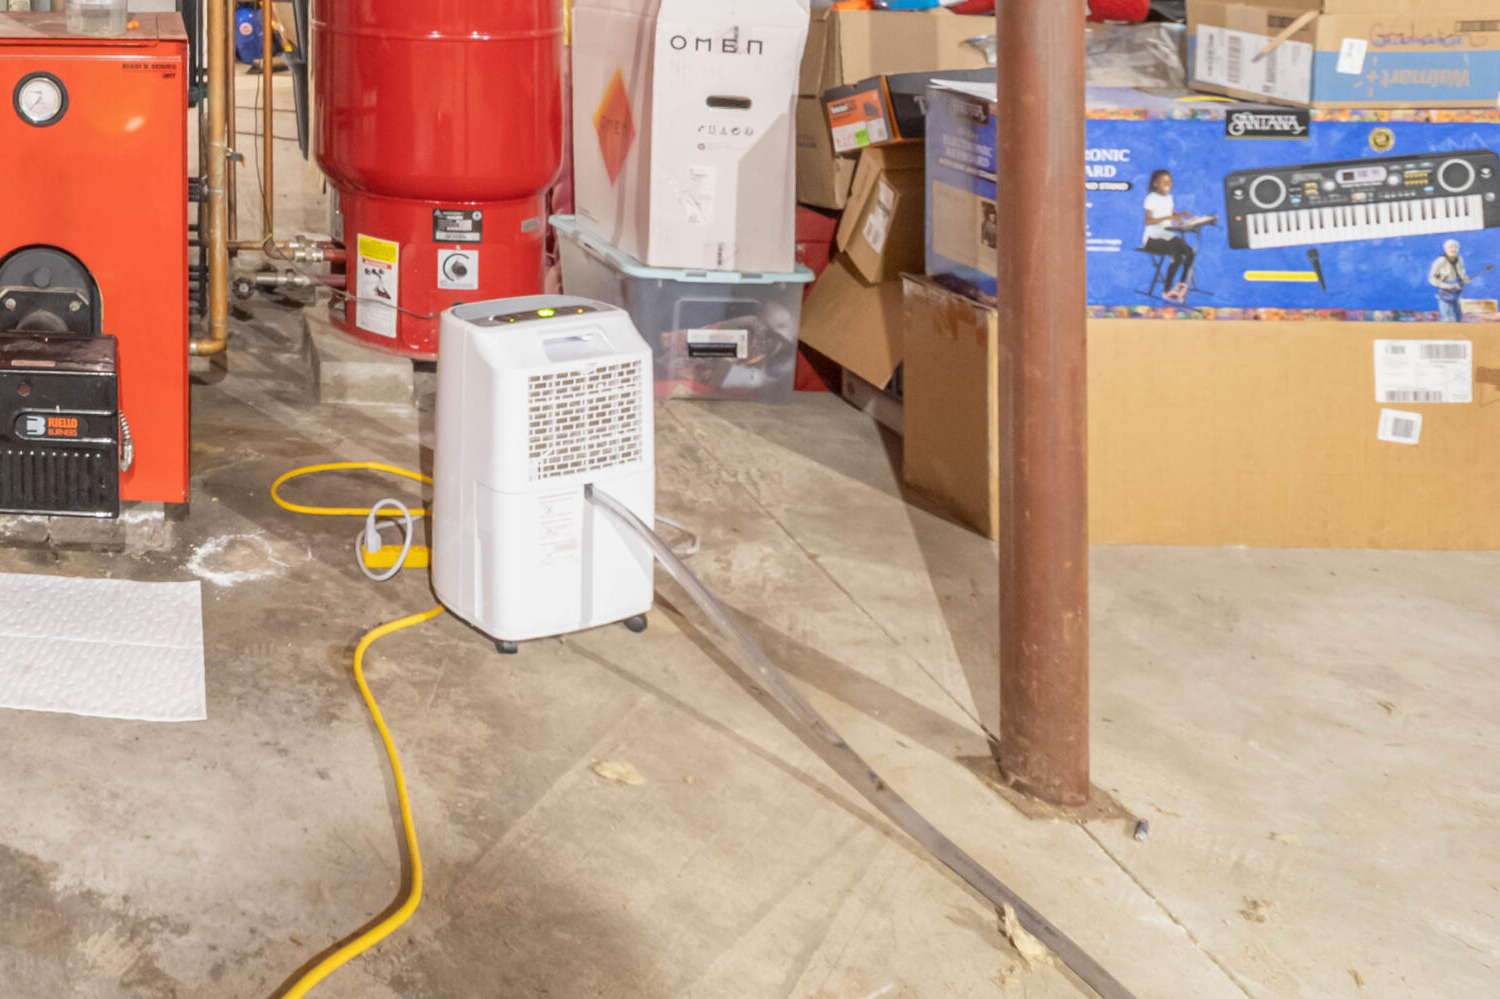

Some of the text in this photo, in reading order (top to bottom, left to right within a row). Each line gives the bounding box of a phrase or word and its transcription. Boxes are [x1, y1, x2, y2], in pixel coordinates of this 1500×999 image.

[1380, 68, 1469, 89] Walmart
[1227, 111, 1307, 136] SANTANA
[1084, 148, 1131, 162] RONIC
[1084, 164, 1117, 178] ARD
[47, 416, 79, 428] RIELLO
